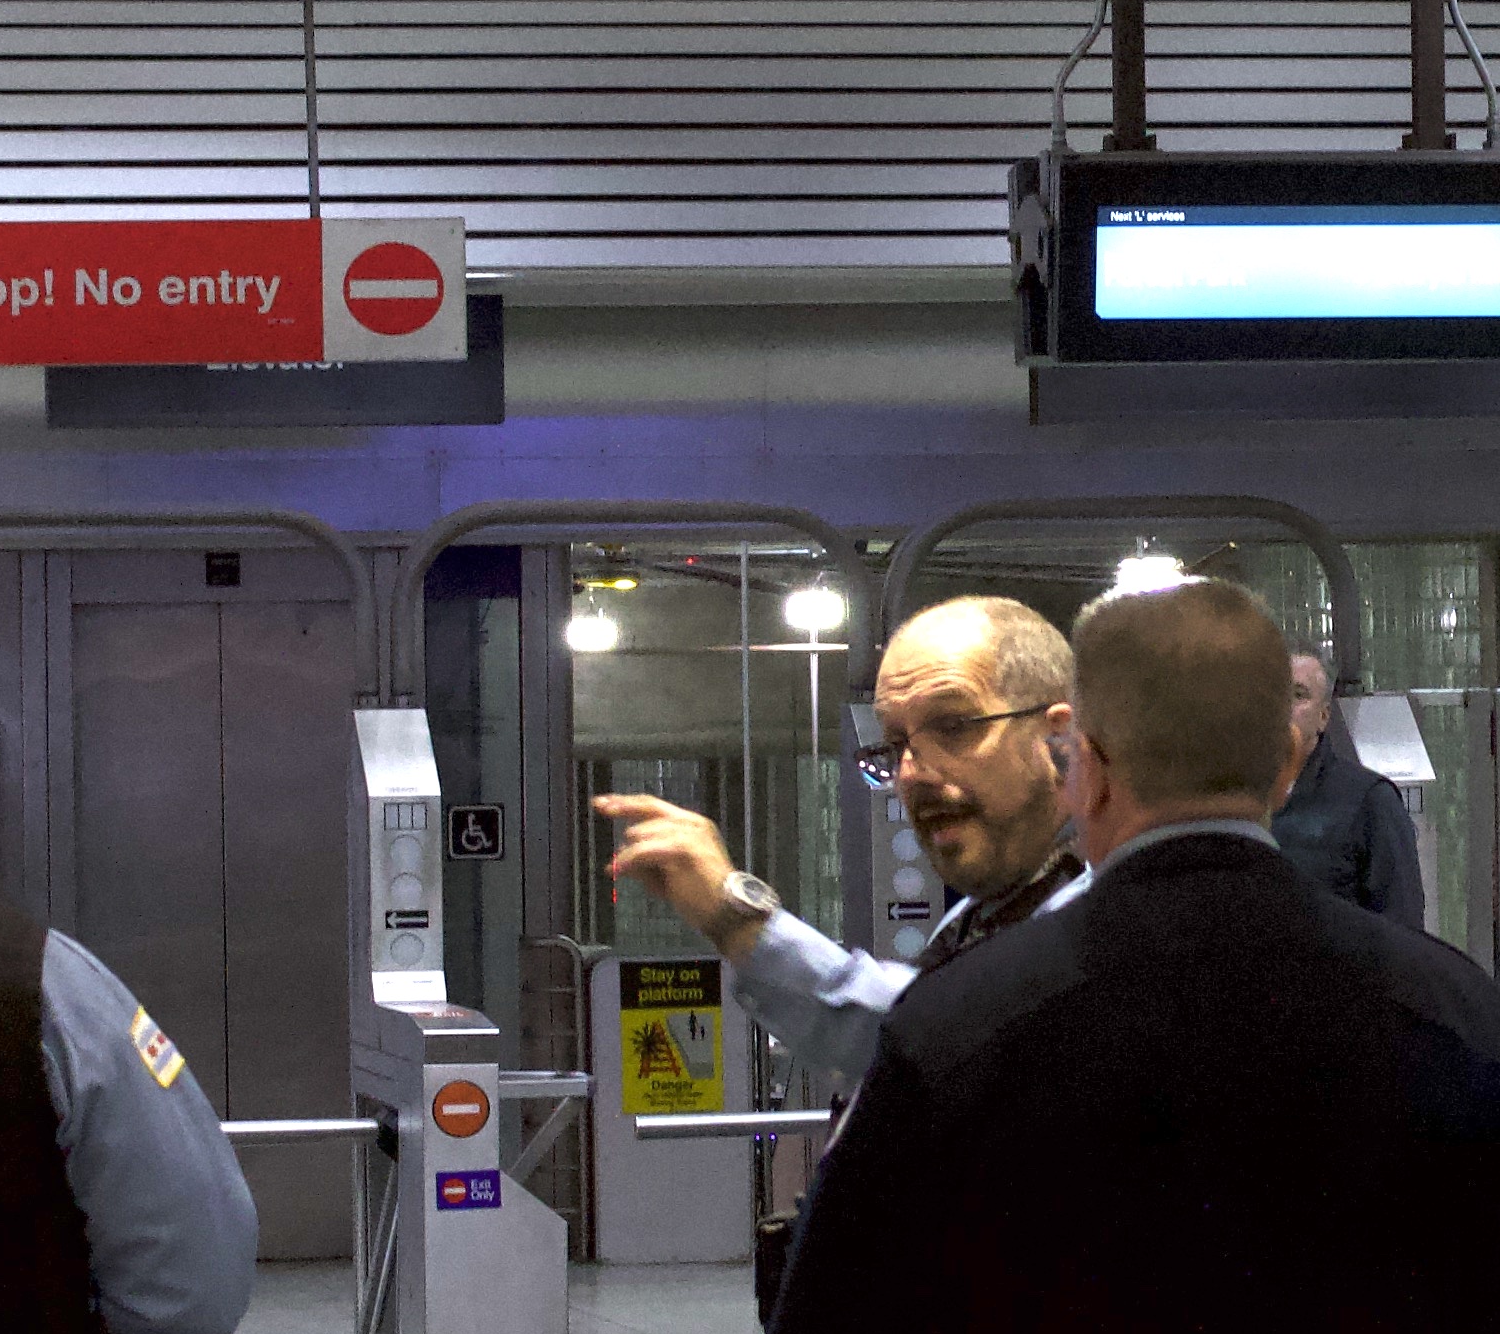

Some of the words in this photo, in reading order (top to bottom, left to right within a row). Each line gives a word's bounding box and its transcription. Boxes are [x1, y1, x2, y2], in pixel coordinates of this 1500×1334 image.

[1110, 210, 1132, 222] Next
[1146, 210, 1186, 222] services
[74, 268, 142, 306] No
[157, 269, 281, 315] entry
[640, 967, 675, 985] Stay
[679, 969, 700, 982] on
[638, 987, 703, 1006] platform
[651, 1080, 693, 1093] Danger
[470, 1178, 491, 1190] Exit
[470, 1190, 495, 1202] Only
